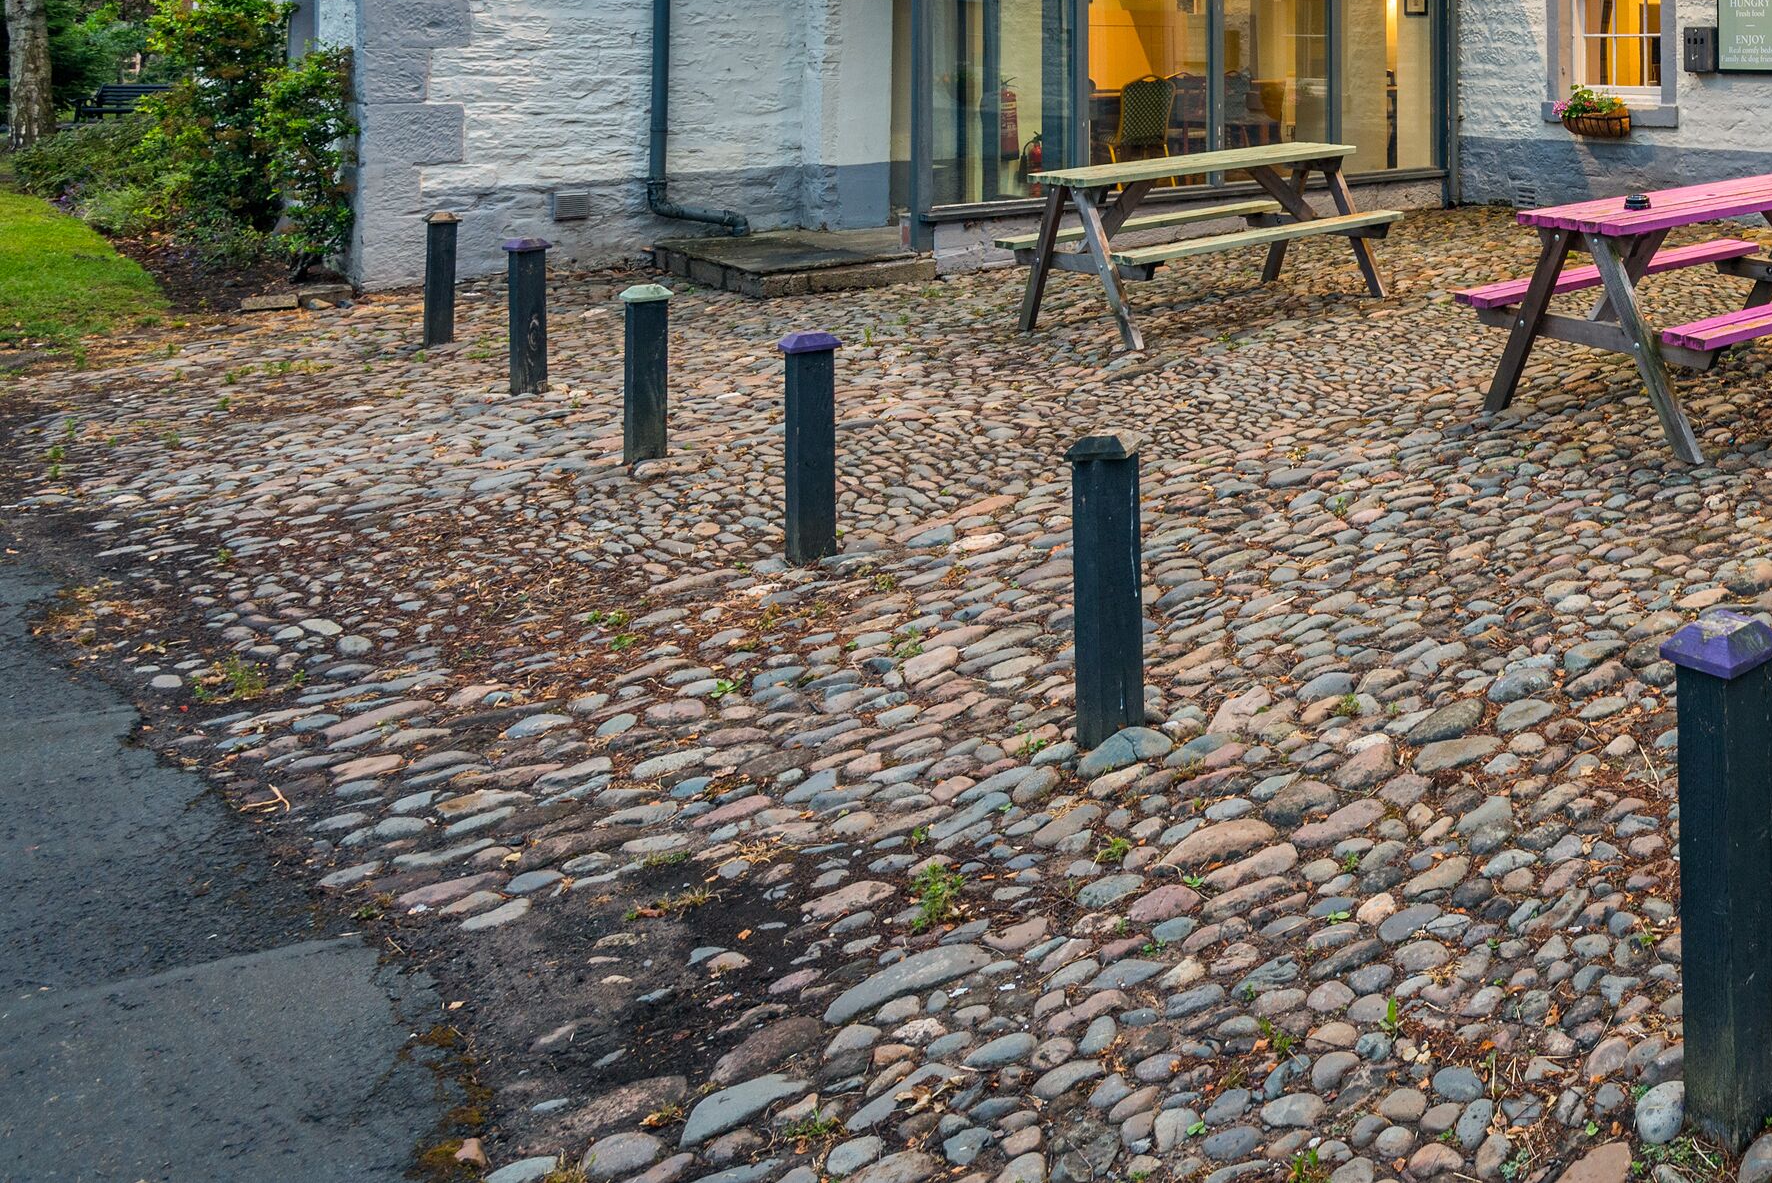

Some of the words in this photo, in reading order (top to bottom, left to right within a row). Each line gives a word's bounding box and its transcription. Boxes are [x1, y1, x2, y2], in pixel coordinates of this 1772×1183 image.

[1735, 9, 1750, 17] Fresh
[1751, 9, 1765, 17] food
[1735, 34, 1766, 46] ENJOY
[1728, 46, 1741, 54] Real
[1721, 54, 1739, 64] Family
